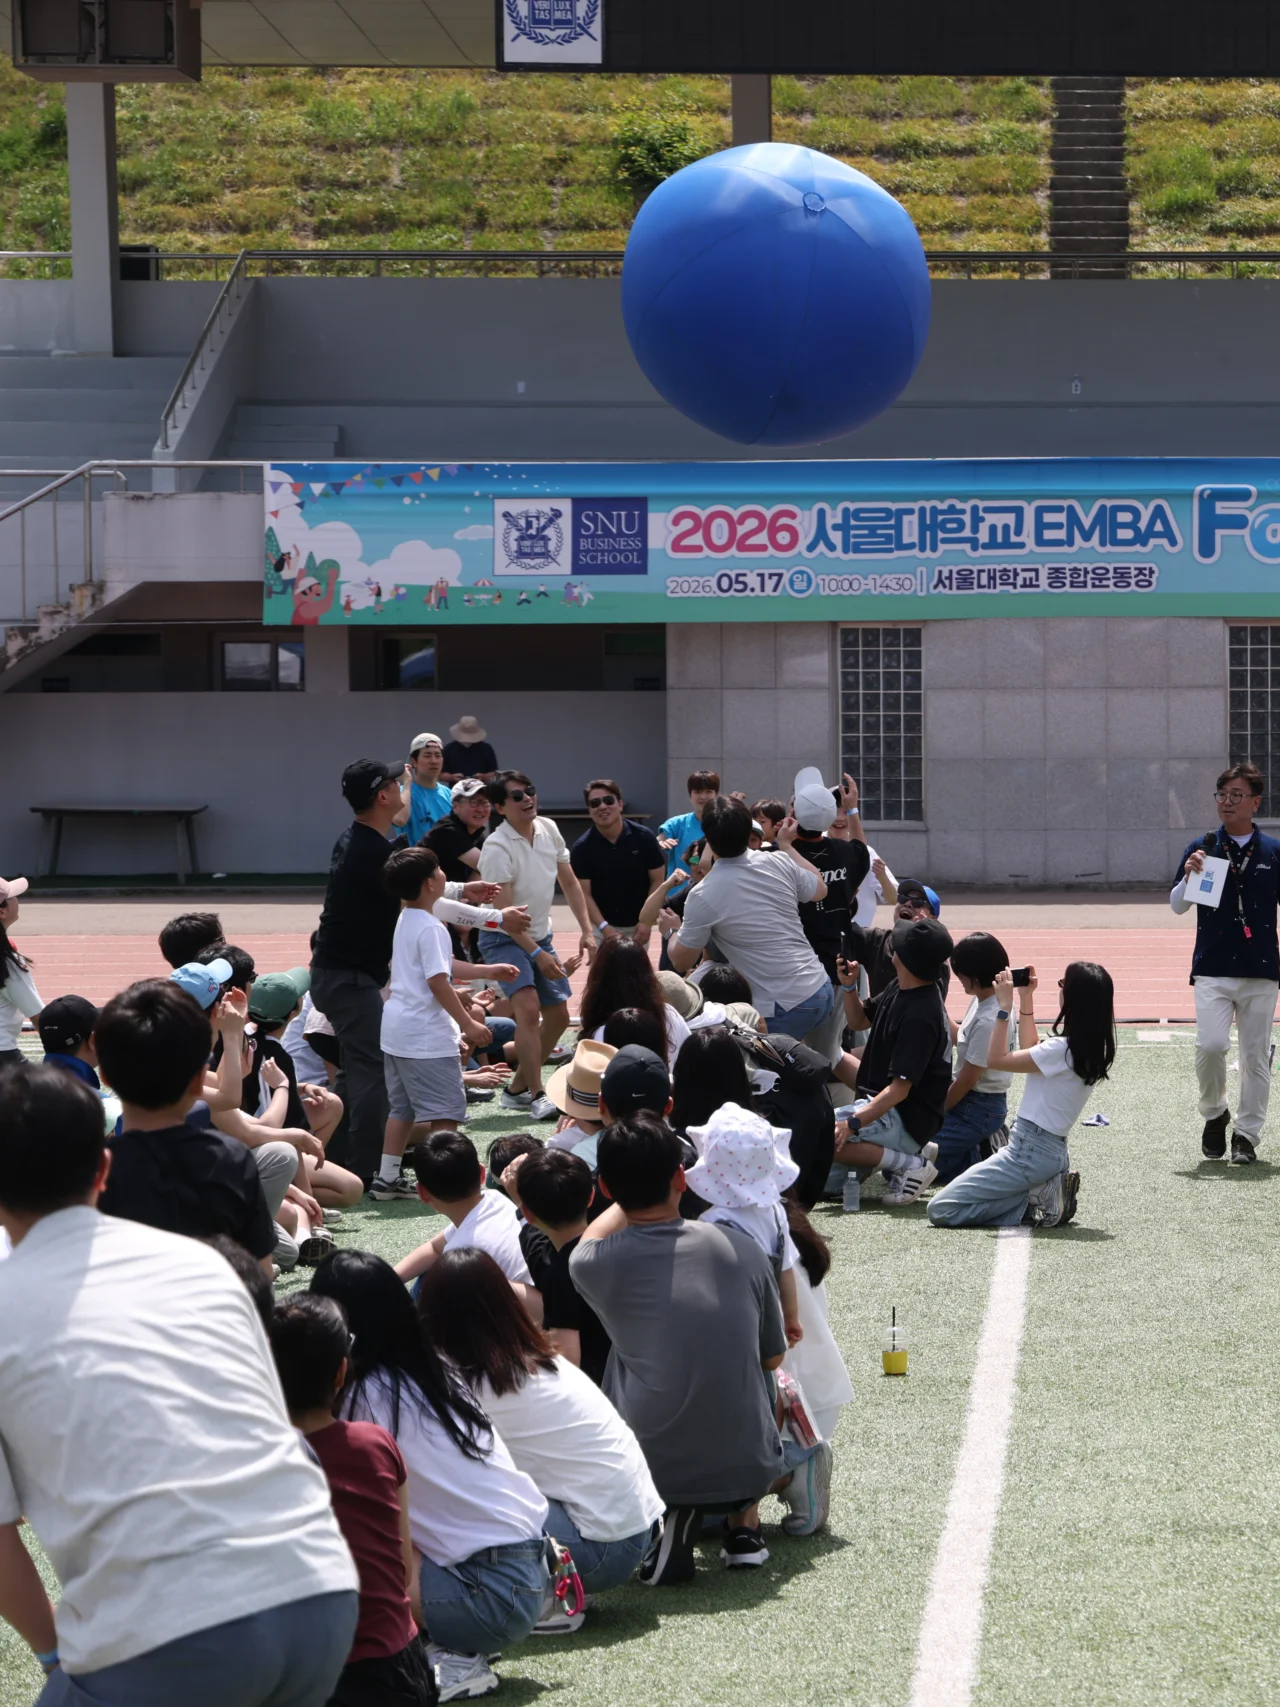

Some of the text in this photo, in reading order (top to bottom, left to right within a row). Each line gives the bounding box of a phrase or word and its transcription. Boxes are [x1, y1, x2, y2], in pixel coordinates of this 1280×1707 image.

[554, 0, 571, 10] LUX
[535, 10, 572, 20] TAS MEA
[580, 511, 640, 535] SNU
[671, 509, 800, 553] 2026
[806, 504, 1026, 554] 서울대학교
[1034, 504, 1178, 548] EMBA
[579, 537, 642, 550] BUSINESS
[579, 551, 642, 564] SCHOOL
[933, 568, 1040, 591] 서울대학교
[1047, 566, 1155, 589] 종합운동장
